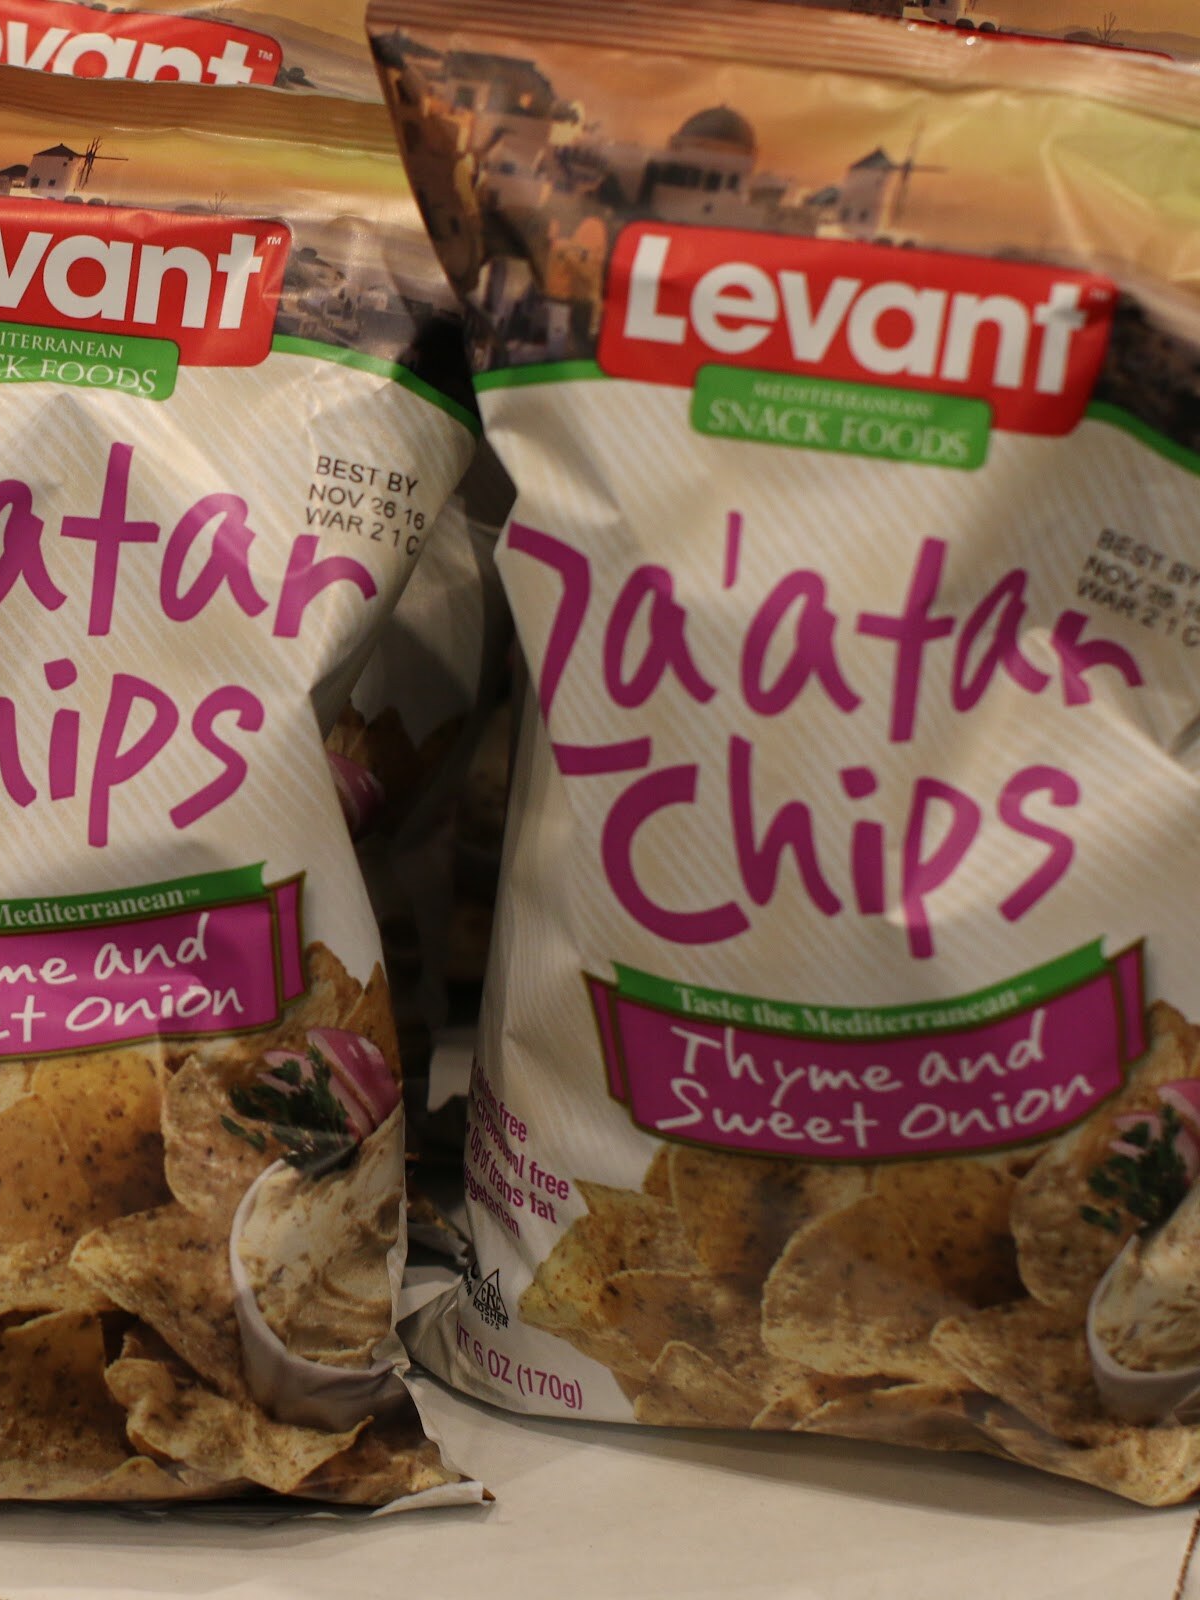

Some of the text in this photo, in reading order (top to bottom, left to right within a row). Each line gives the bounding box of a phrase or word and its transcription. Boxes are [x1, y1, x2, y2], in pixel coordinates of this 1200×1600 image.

[624, 235, 1088, 394] Levant
[40, 358, 157, 394] FOODS
[707, 397, 970, 462] SNACK FOODS
[316, 455, 418, 496] BEST BY
[306, 507, 363, 536] WAR
[309, 483, 425, 531] NOV 26 16
[1083, 555, 1145, 592] NOV
[1097, 528, 1165, 572] BEST
[601, 734, 1080, 960] Chips
[94, 912, 210, 982] and
[673, 985, 746, 1022] Taste
[752, 998, 795, 1031] the
[670, 1008, 1047, 1107] Thyme and
[499, 1102, 528, 1143] free
[655, 1078, 879, 1148] Sweet
[489, 1159, 524, 1207] trans
[529, 1191, 557, 1224] fat
[529, 1161, 570, 1200] free
[488, 1349, 512, 1384] OZ
[517, 1364, 583, 1410] (170g)
